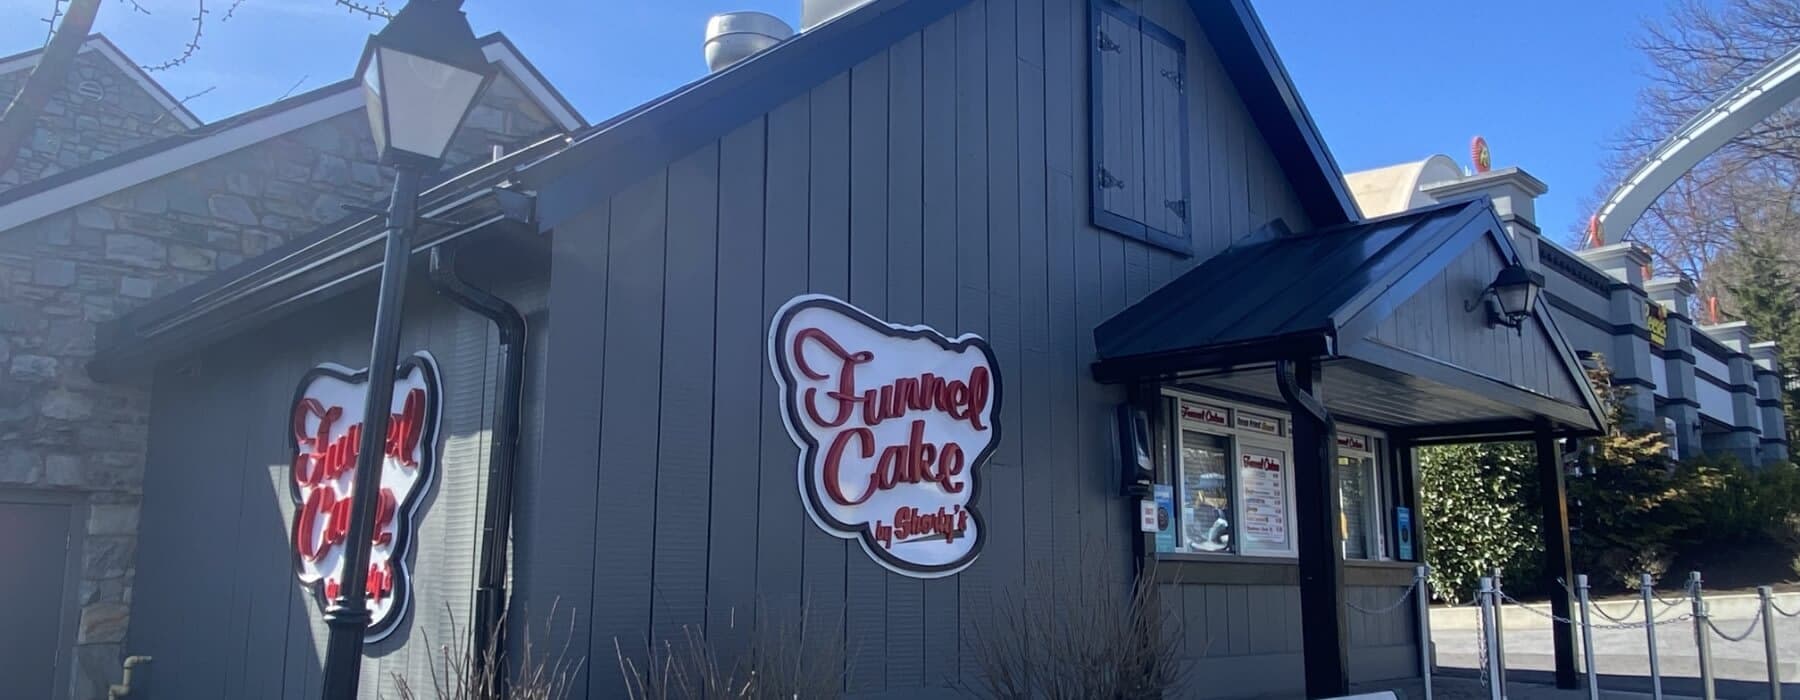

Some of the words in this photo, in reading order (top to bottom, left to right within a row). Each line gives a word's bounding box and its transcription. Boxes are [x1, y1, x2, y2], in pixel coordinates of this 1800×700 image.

[794, 328, 989, 431] Funnel
[295, 387, 425, 487] Funel
[823, 420, 964, 505] Cake
[297, 486, 396, 563] Cae
[876, 520, 892, 549] by
[894, 504, 968, 544] Shorty's
